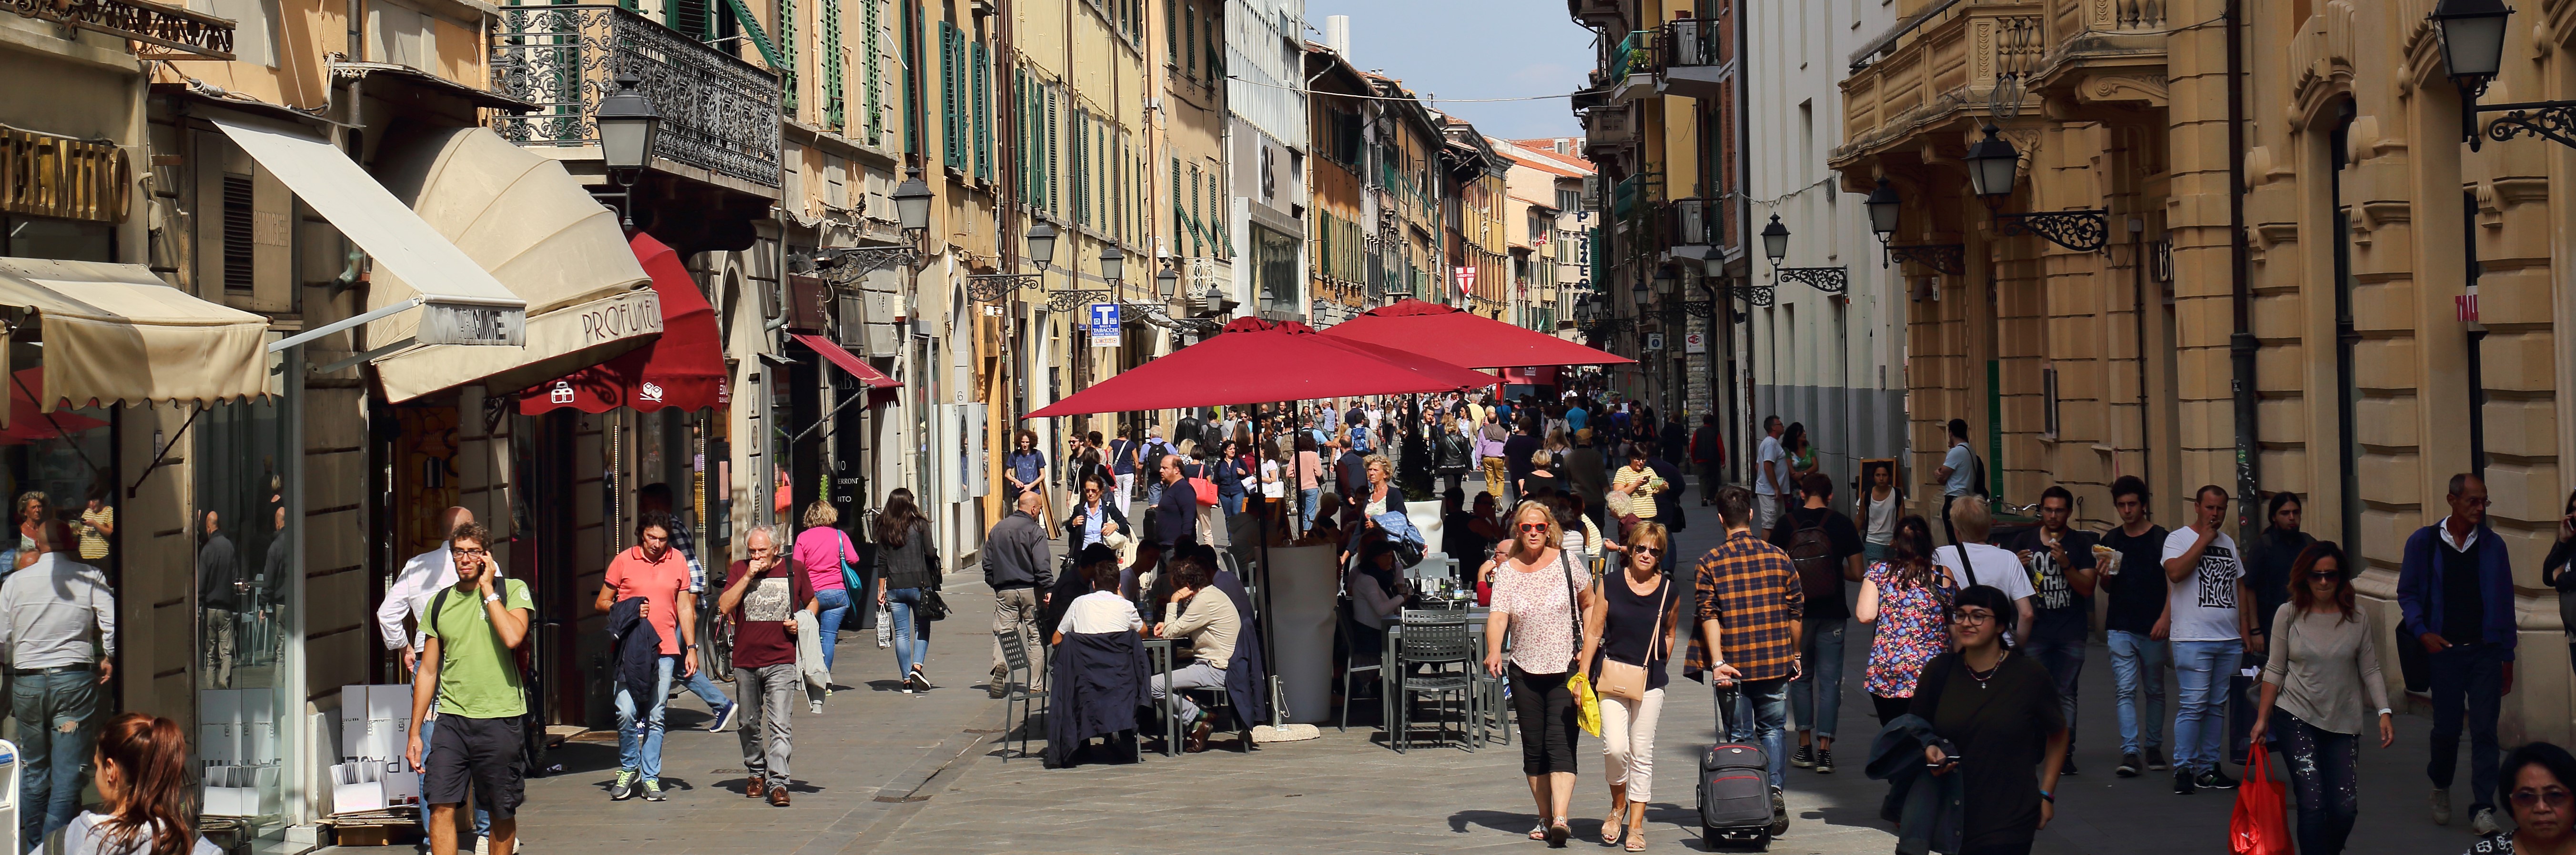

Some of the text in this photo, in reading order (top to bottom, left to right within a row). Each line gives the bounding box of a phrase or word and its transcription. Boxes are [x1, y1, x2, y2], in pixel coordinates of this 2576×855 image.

[254, 210, 288, 247] CAMICIE
[1096, 306, 1114, 324] T
[957, 391, 963, 401] 6
[2205, 548, 2229, 556] IKE
[755, 591, 782, 605] Originals
[2043, 590, 2072, 609] WAY
